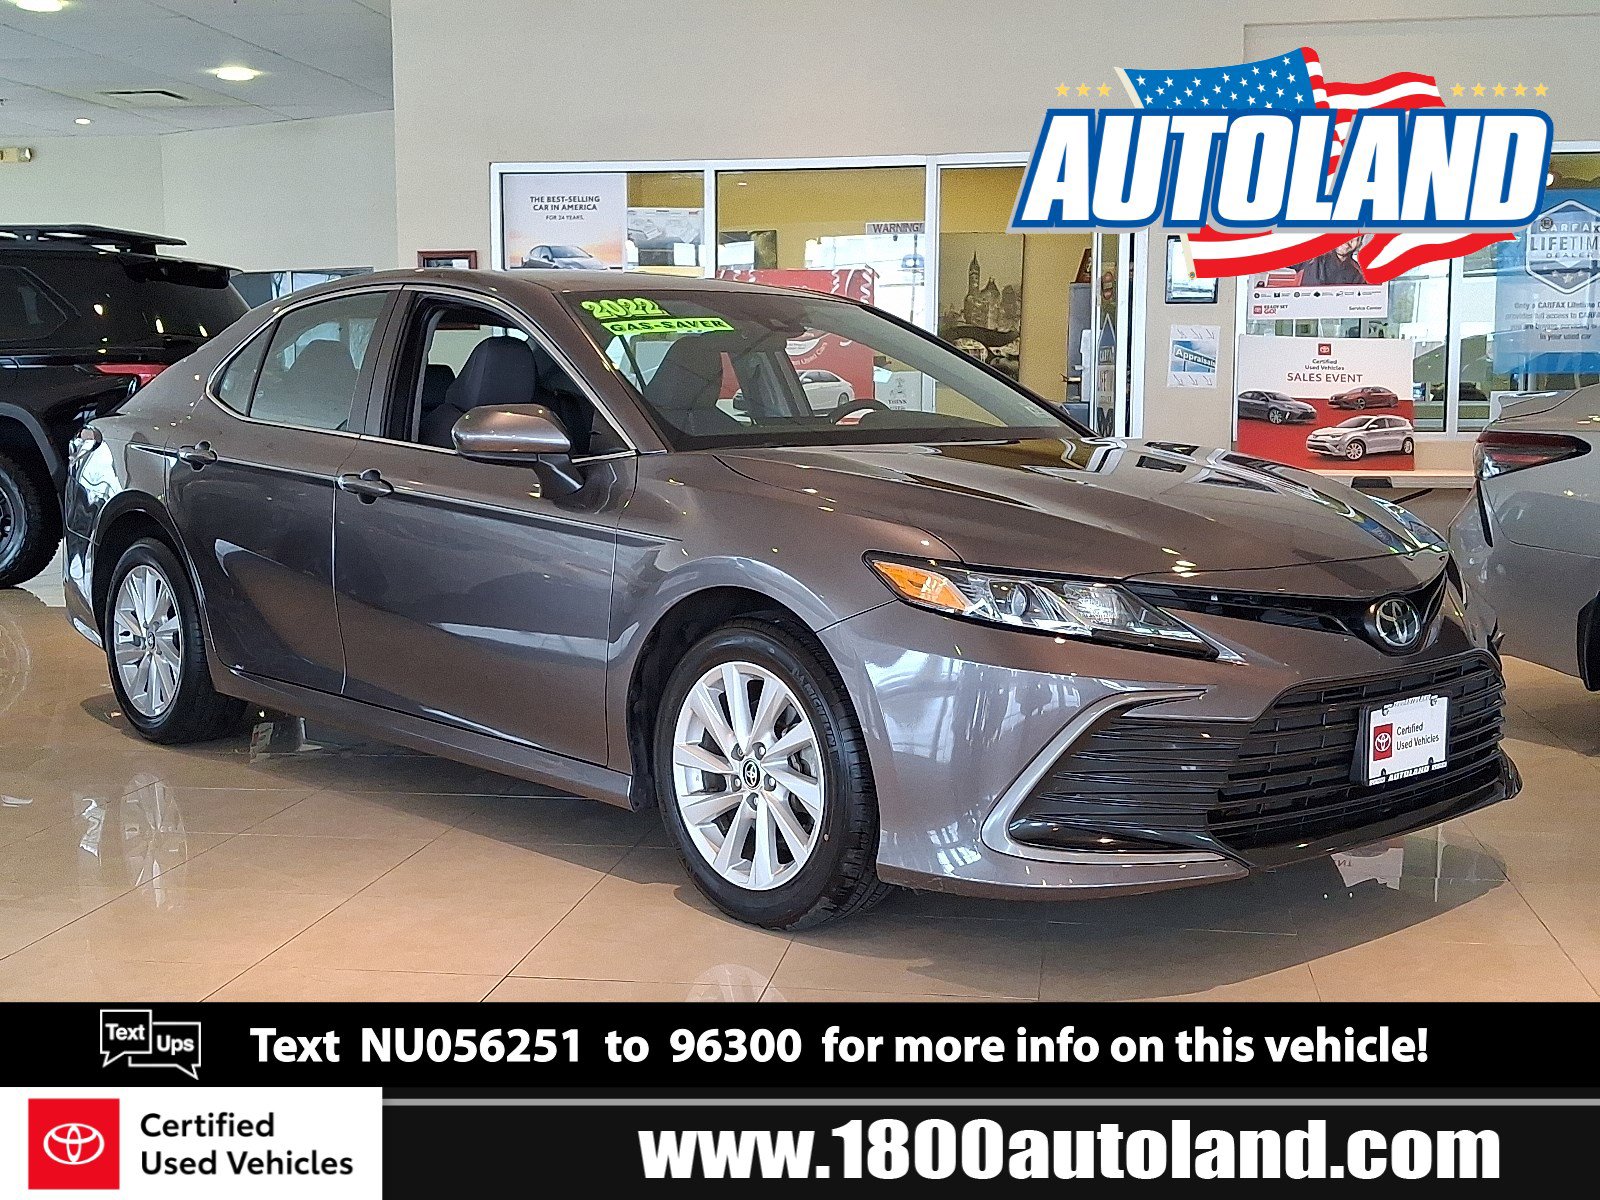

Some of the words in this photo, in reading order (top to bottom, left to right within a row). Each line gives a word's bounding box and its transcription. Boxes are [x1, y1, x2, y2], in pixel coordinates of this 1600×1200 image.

[872, 222, 924, 234] WARNING!
[581, 297, 671, 319] 2022
[1537, 301, 1566, 309] CARFAX
[609, 320, 727, 332] GAS-SAVER
[1287, 372, 1322, 382] SALES
[1325, 373, 1363, 383] EVENT
[1396, 721, 1424, 736] Certified
[1396, 737, 1413, 751] Used
[1413, 733, 1440, 747] Vehicles
[1387, 765, 1430, 782] AUTOLAND
